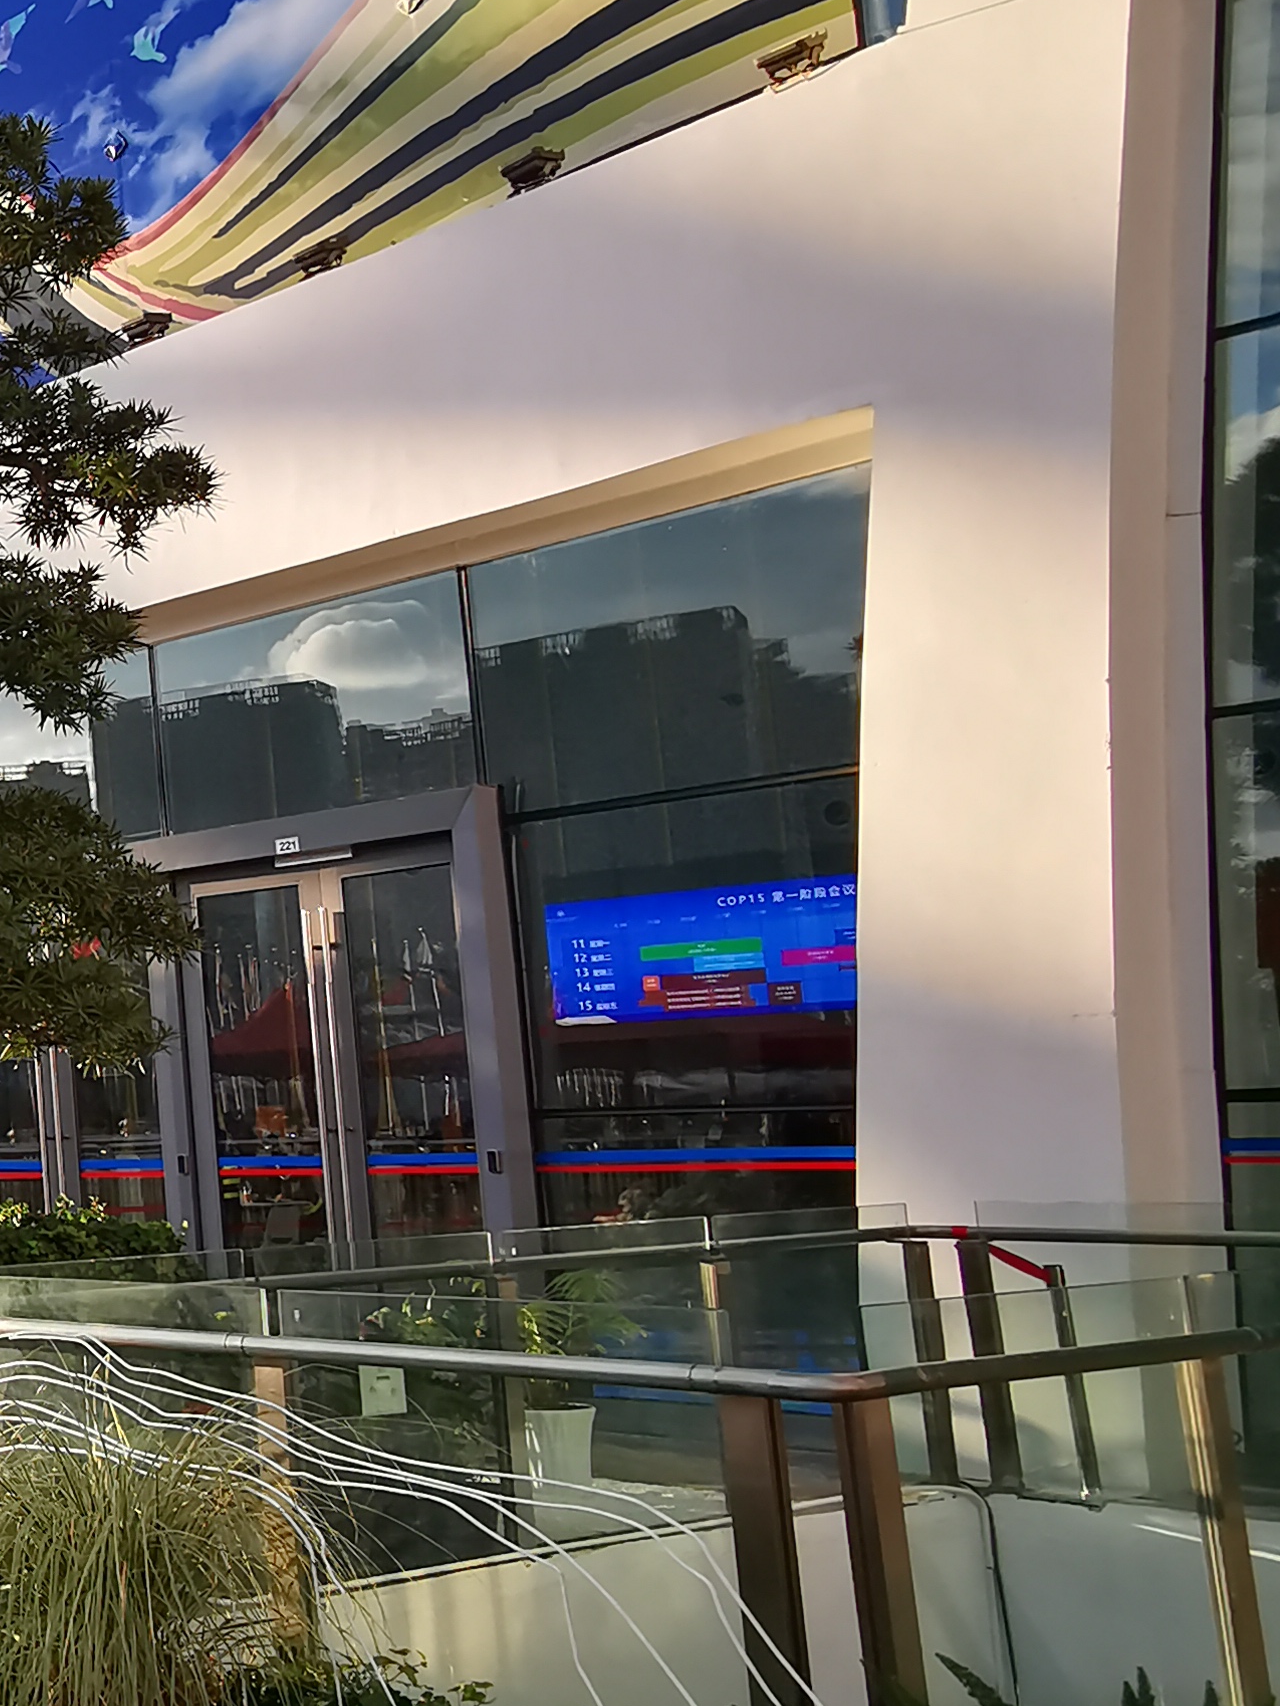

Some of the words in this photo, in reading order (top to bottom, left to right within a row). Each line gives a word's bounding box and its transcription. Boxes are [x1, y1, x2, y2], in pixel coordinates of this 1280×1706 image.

[279, 840, 297, 852] 221
[716, 893, 765, 907] COP15
[571, 939, 585, 949] 11
[574, 953, 587, 963] 12
[575, 968, 589, 978] 13
[577, 982, 591, 992] 14
